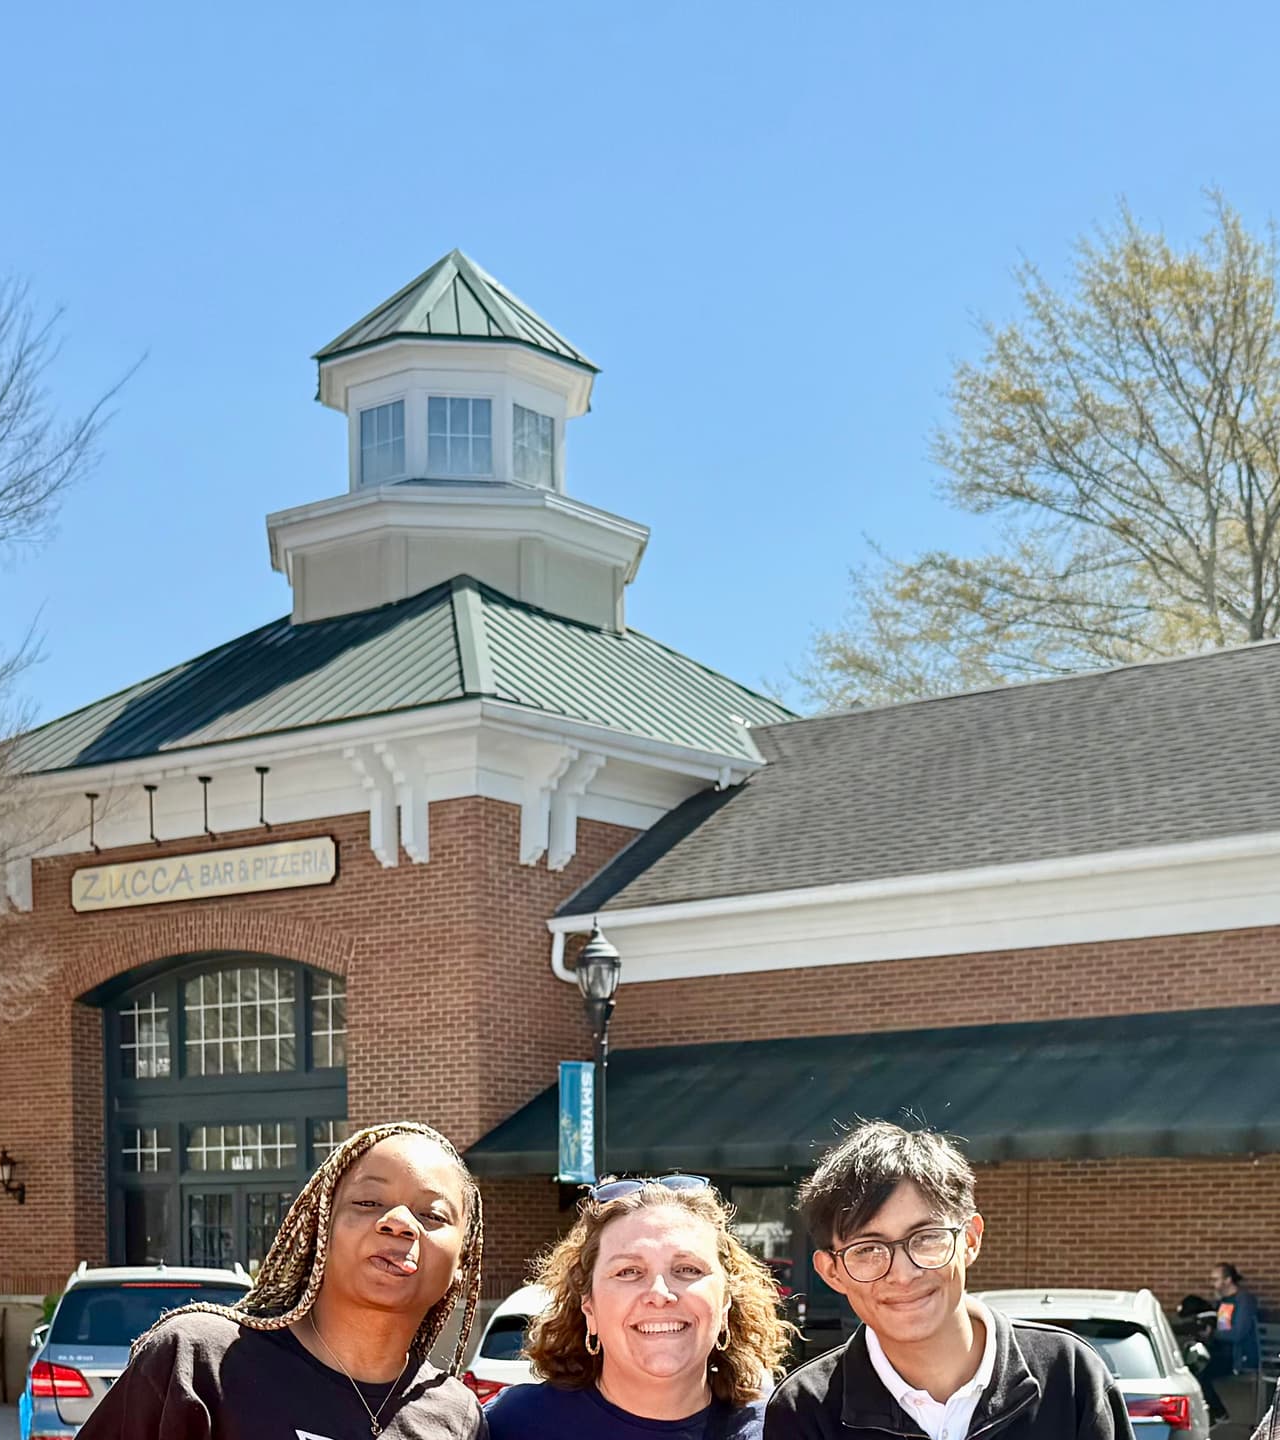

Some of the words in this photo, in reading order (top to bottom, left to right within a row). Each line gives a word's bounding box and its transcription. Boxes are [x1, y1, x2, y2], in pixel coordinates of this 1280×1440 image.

[80, 863, 194, 902] ZUCCA
[200, 861, 234, 887] BAR
[253, 849, 331, 881] PIZZERIA
[580, 1071, 594, 1167] SMYRNA
